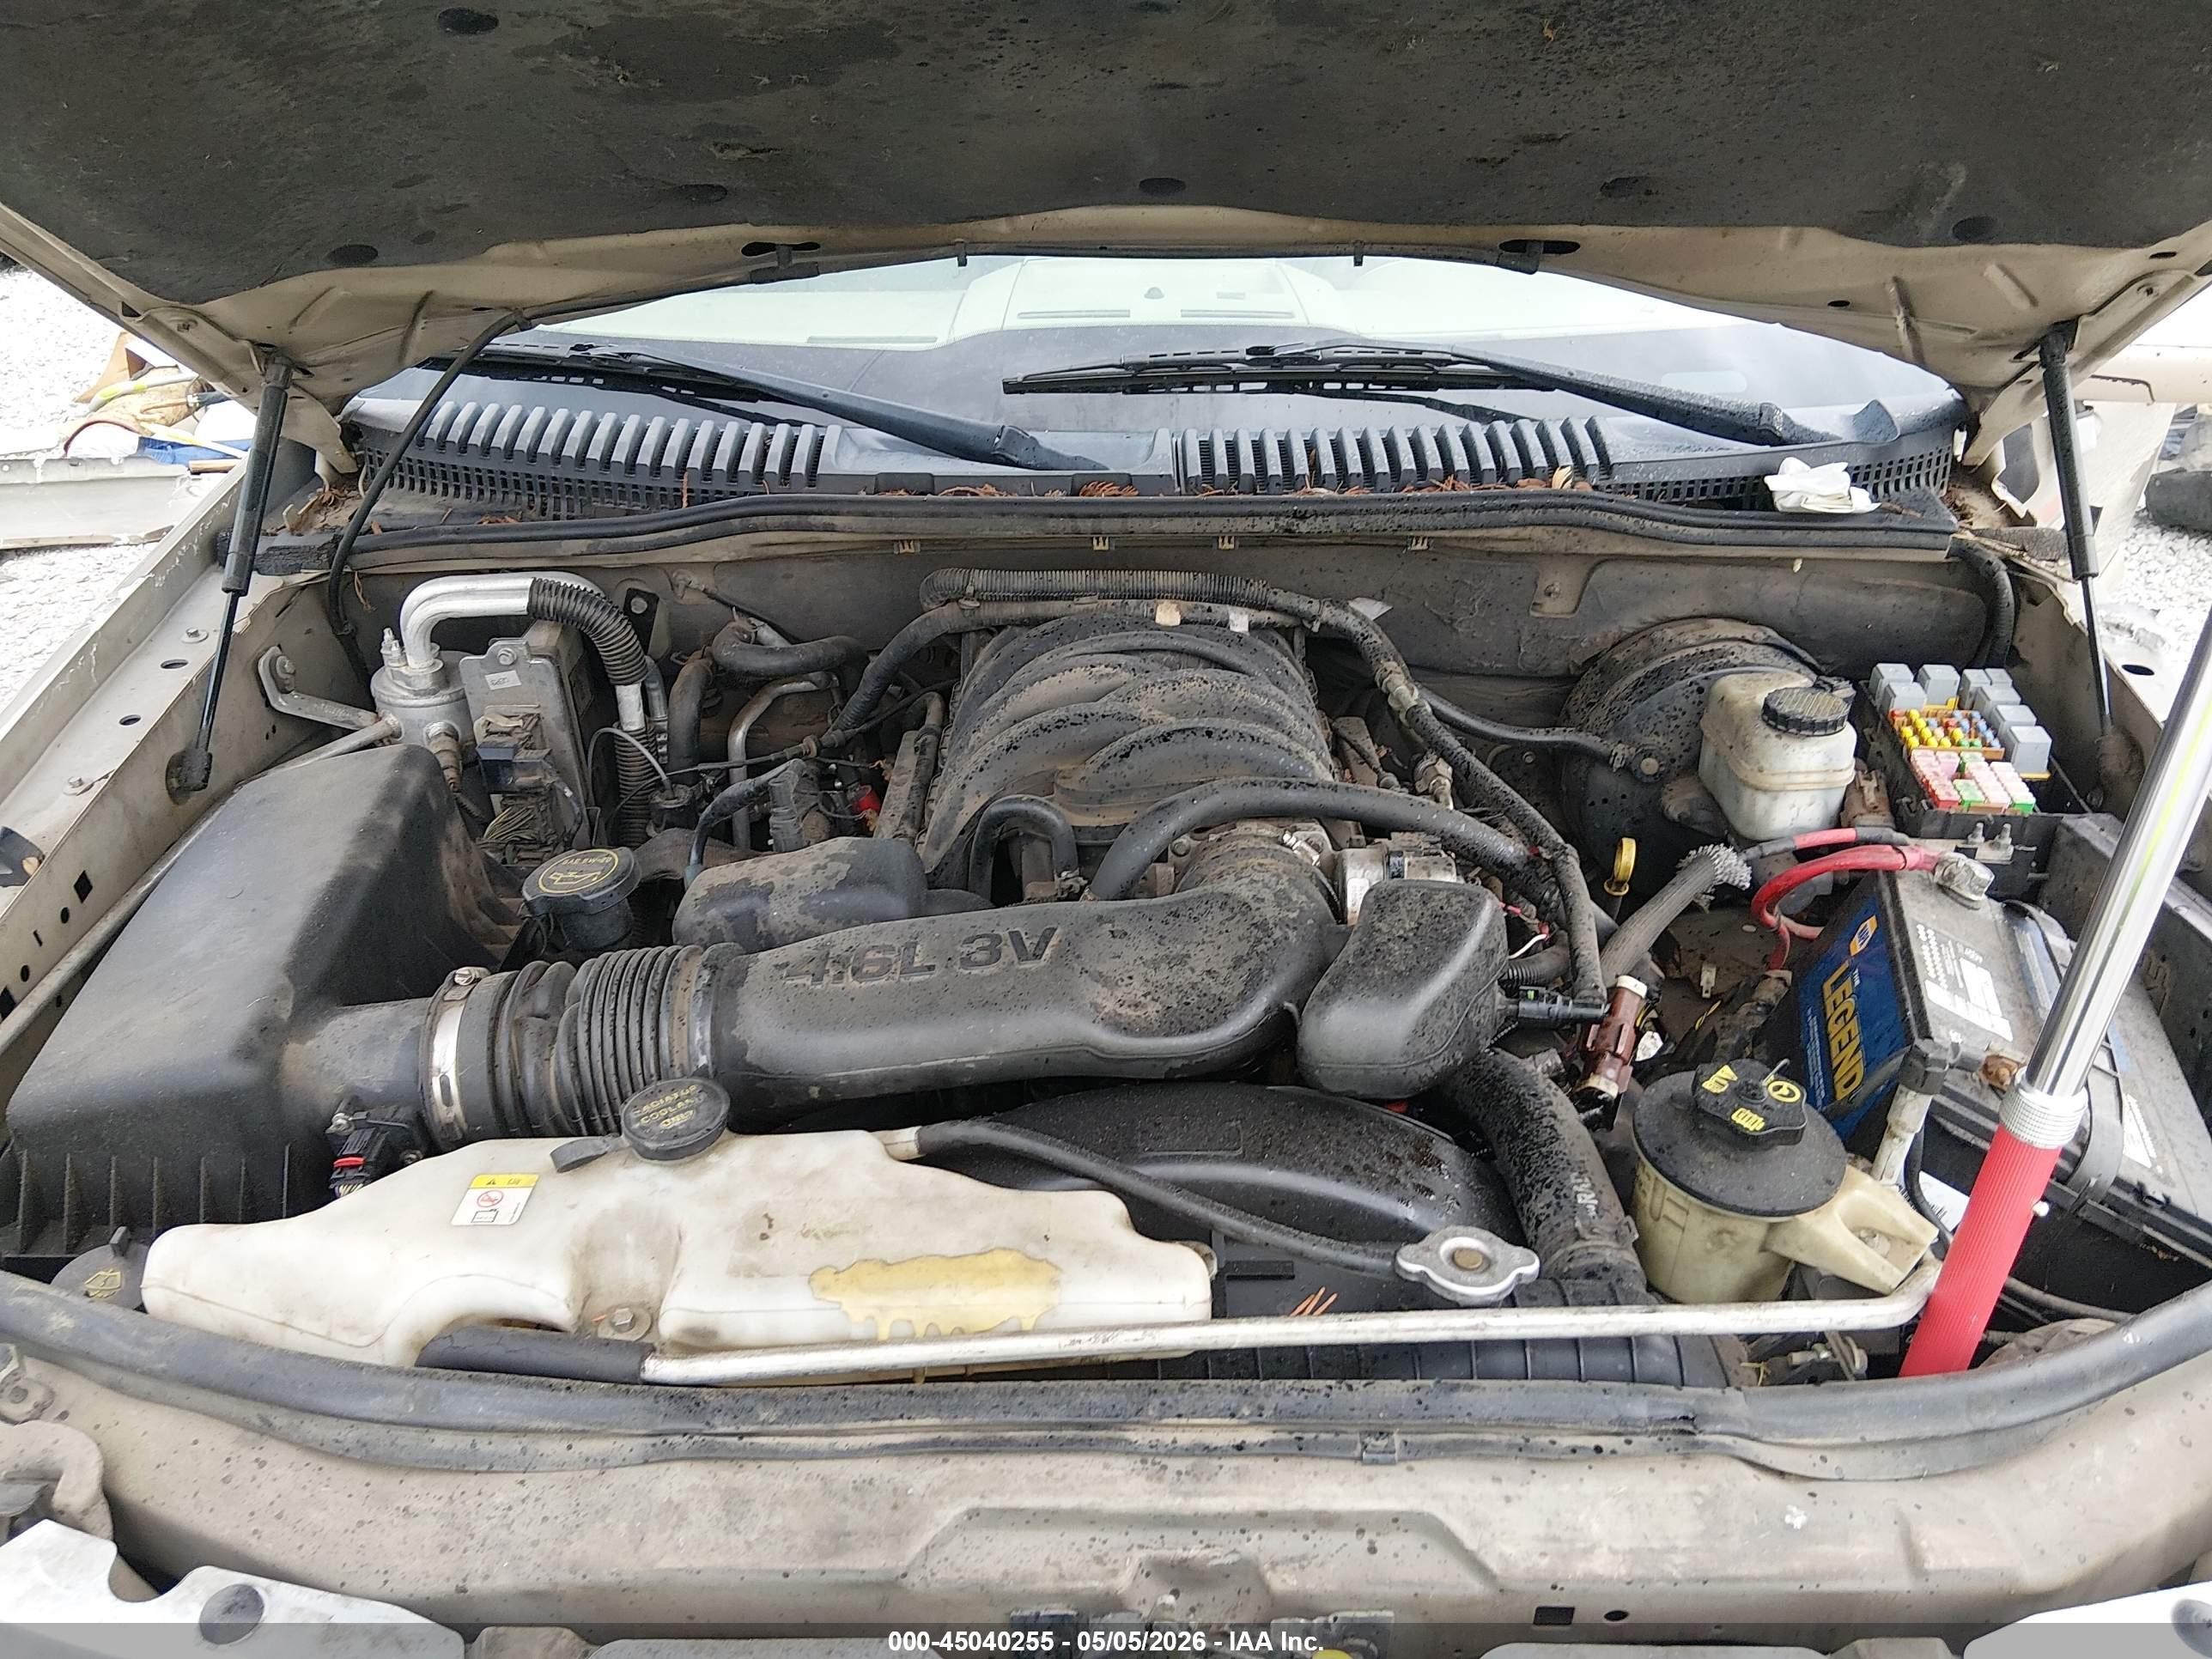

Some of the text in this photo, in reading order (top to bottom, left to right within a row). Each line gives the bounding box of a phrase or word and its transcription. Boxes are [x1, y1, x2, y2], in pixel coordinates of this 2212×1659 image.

[781, 927, 1059, 986] 4.6L 3V
[1823, 959, 1865, 1101] LEGEND
